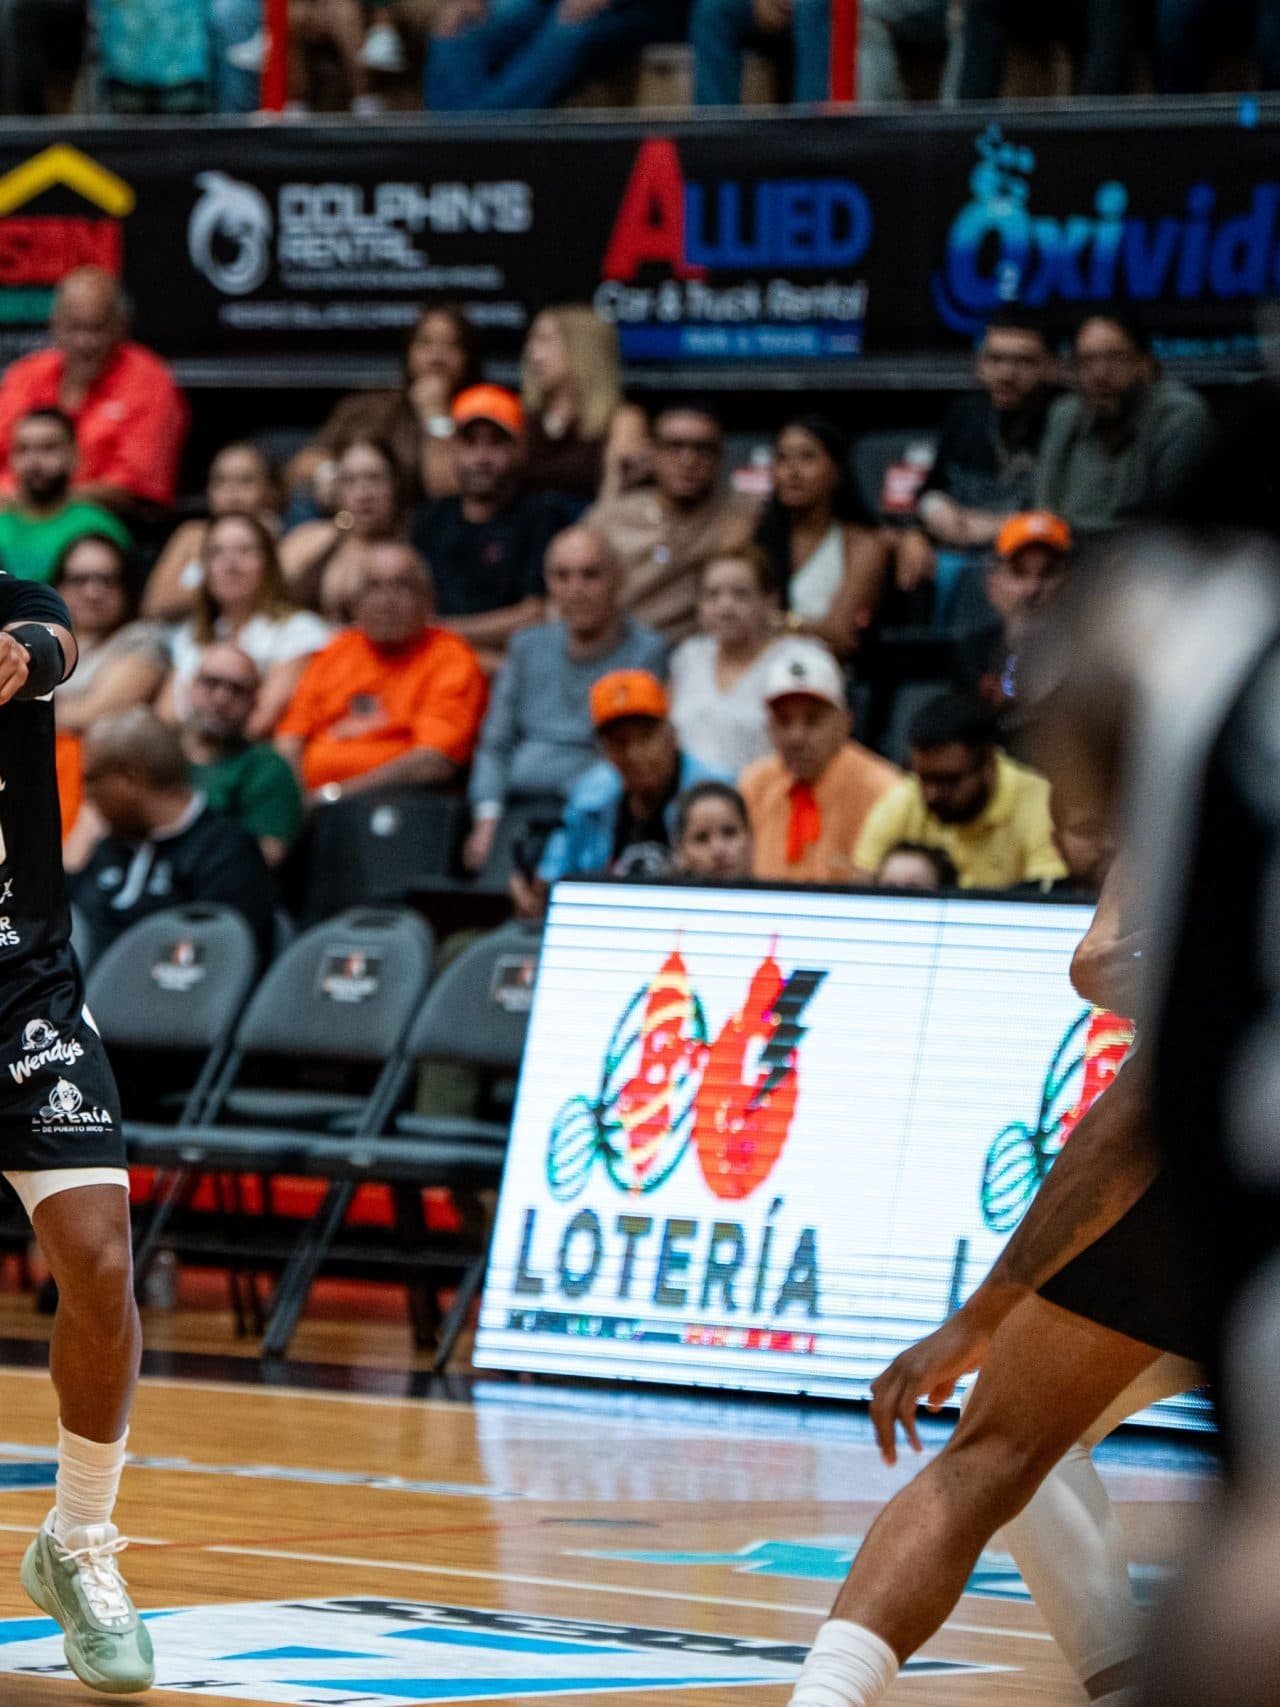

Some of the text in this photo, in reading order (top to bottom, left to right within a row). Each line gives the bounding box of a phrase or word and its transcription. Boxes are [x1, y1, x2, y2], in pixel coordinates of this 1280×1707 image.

[602, 136, 874, 283] ALLIED
[948, 182, 1280, 305] Oxivid
[9, 1039, 85, 1084] Wendy's
[515, 1196, 821, 1318] LOTERÍA
